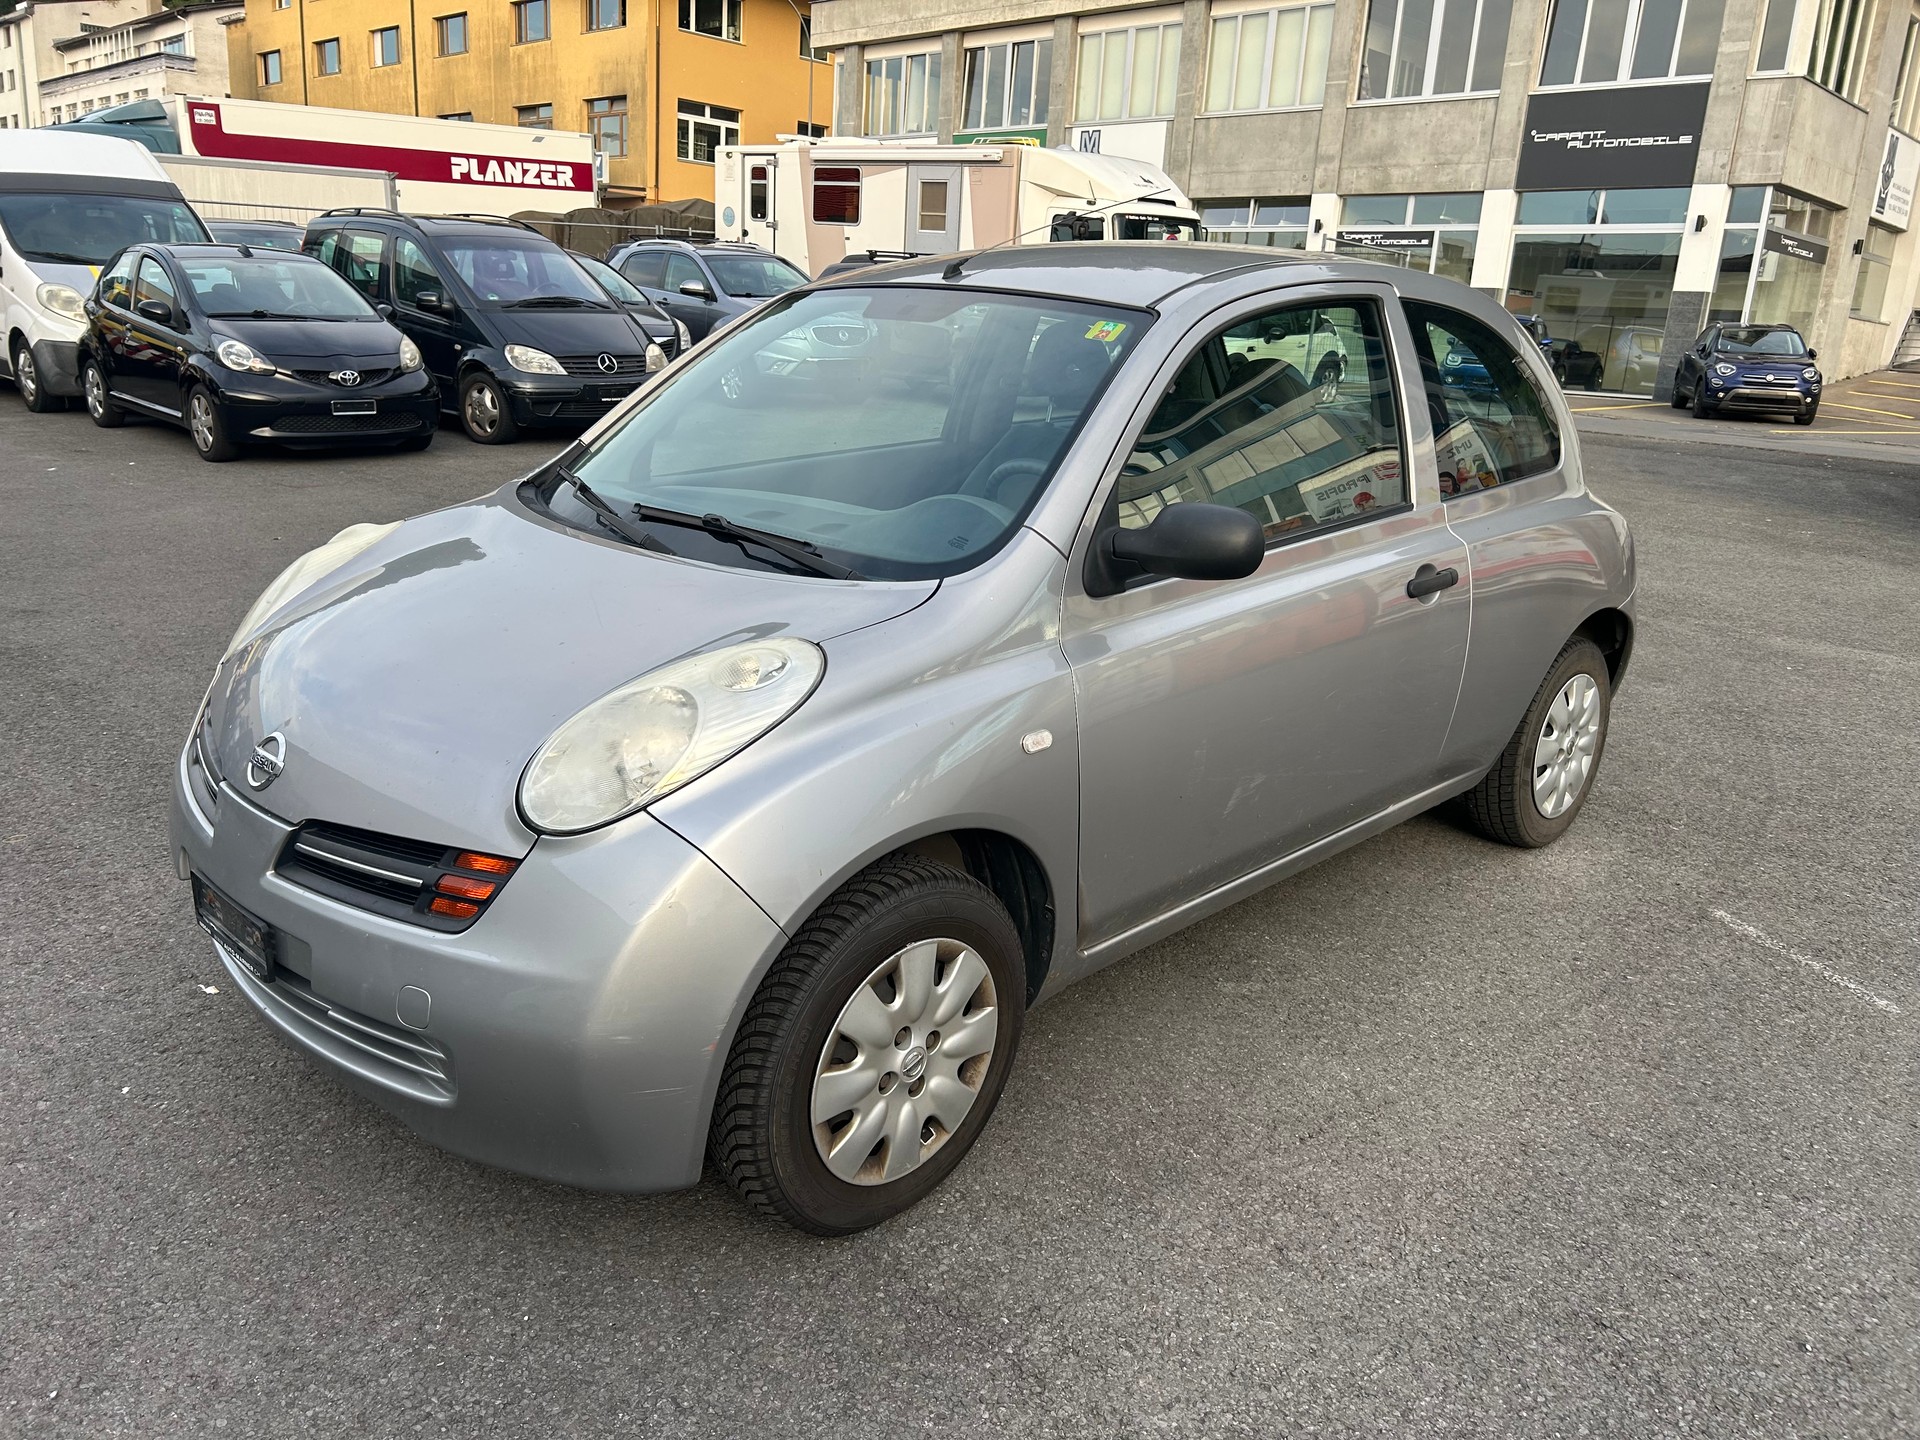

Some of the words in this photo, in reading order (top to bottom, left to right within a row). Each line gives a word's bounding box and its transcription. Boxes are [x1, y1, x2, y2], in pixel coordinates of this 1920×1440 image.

[1534, 131, 1606, 142] CARANT
[1567, 136, 1693, 149] AUTOMOBILE
[451, 157, 575, 188] PLANZER
